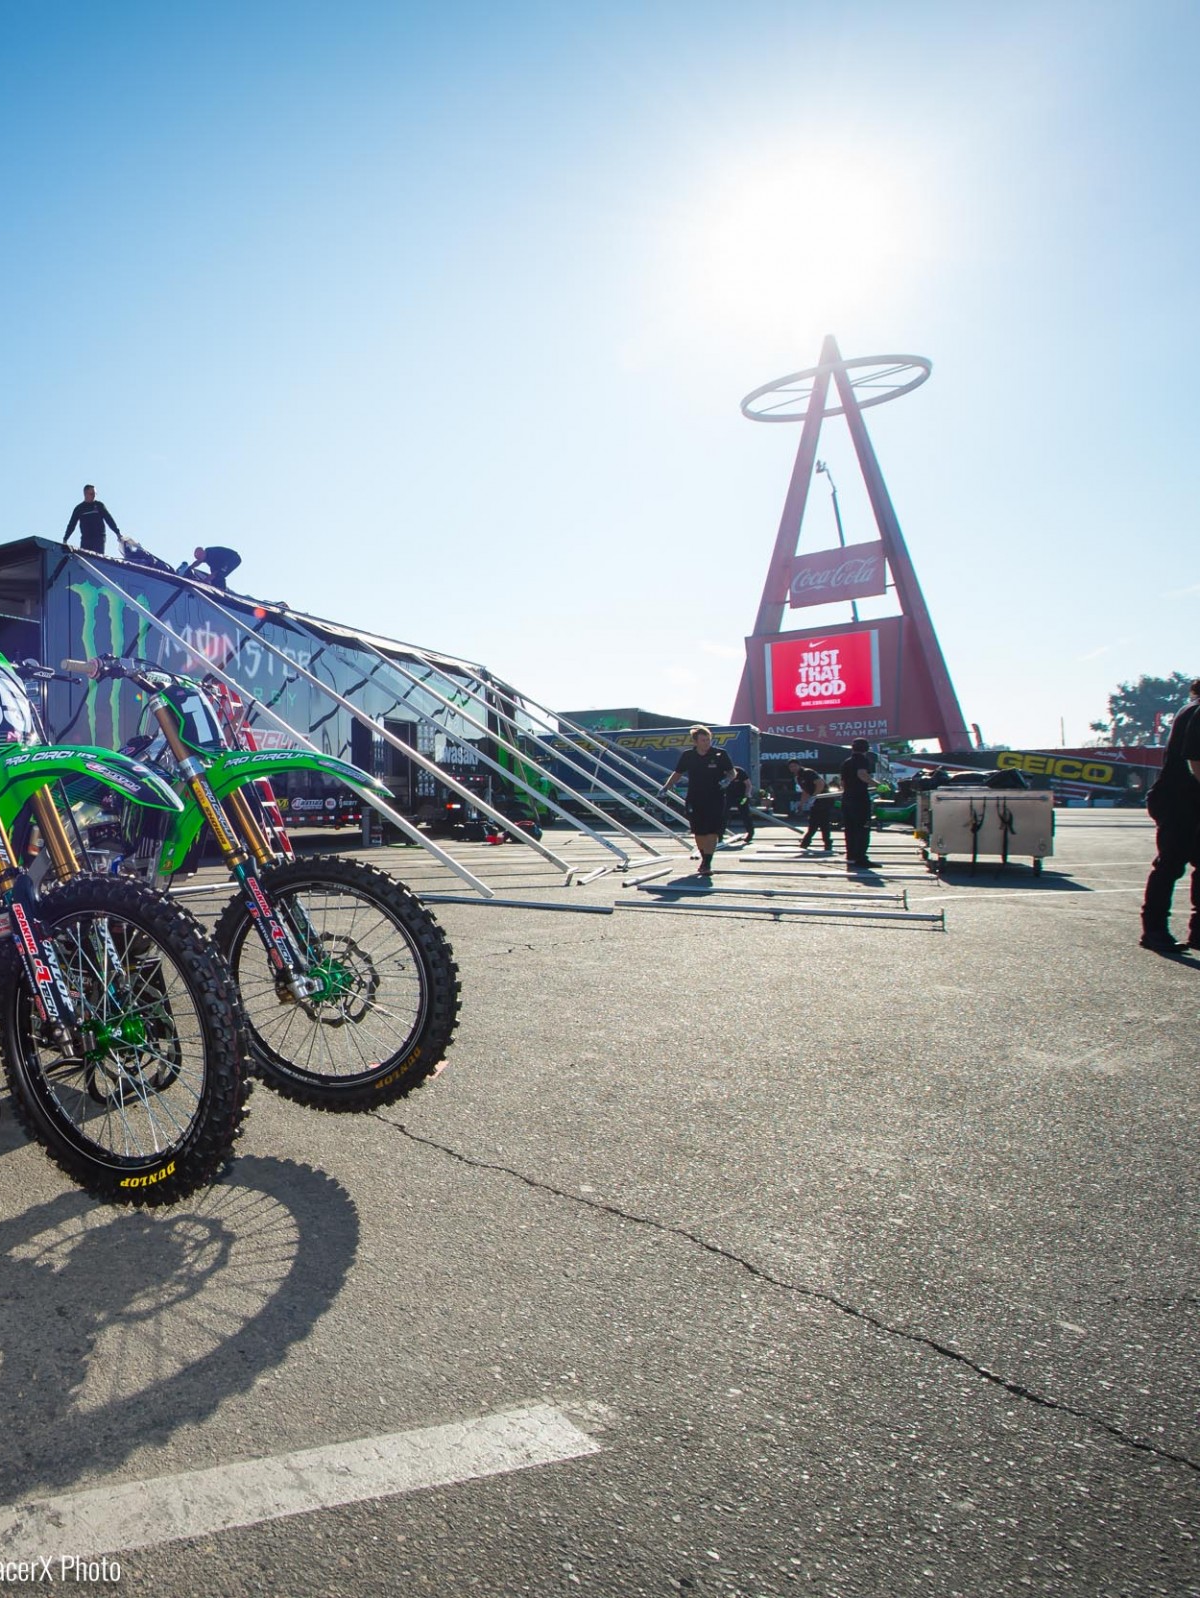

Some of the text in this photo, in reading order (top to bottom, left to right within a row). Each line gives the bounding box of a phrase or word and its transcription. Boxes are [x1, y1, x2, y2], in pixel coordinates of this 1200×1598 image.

[800, 649, 840, 667] JUST
[798, 664, 842, 682] THAT
[795, 679, 846, 699] GOOD
[767, 720, 888, 735] ANGEL STADIUM
[835, 729, 888, 738] ANAHEIM
[437, 740, 479, 764] awasaki
[760, 750, 819, 761] awasaki
[996, 751, 1115, 784] GEICO
[200, 780, 216, 802] PRO
[210, 801, 236, 844] CIRCUIT
[246, 877, 273, 918] BRAKING
[12, 903, 39, 956] BRAKING
[119, 1160, 176, 1187] DUNLOP
